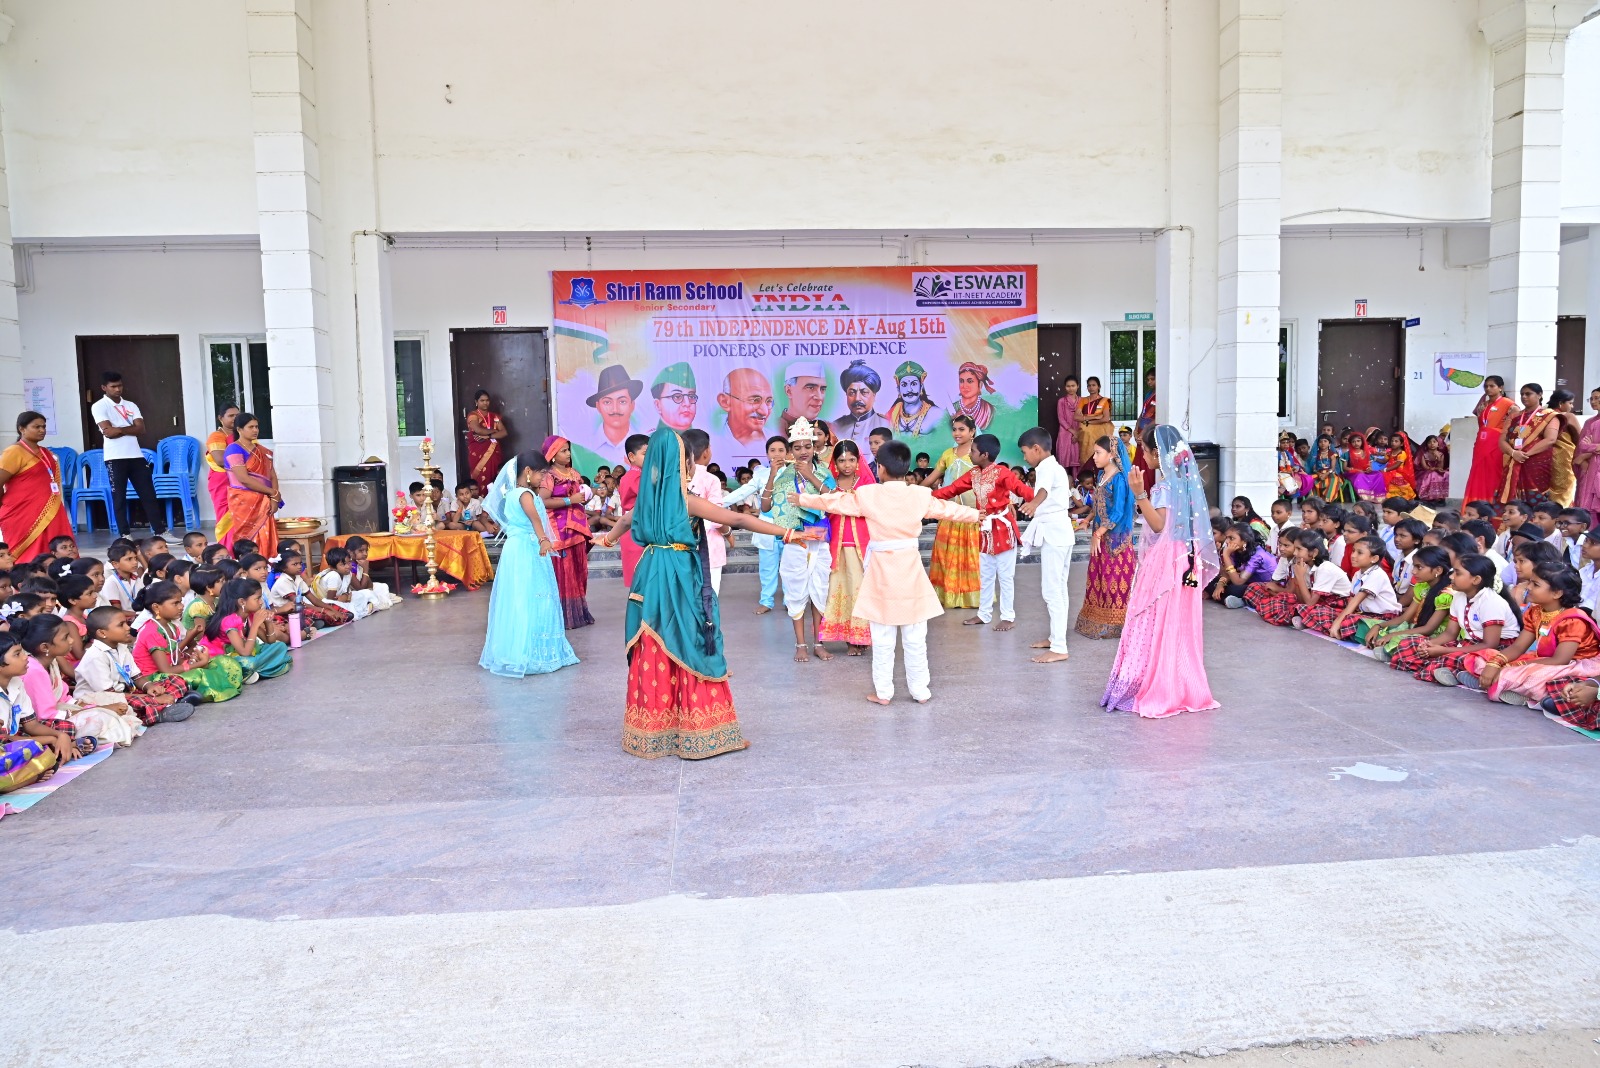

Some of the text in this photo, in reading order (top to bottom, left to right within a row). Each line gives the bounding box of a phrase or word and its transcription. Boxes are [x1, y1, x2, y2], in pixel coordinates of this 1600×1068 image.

[759, 283, 834, 293] Let's Celebrate
[954, 274, 1024, 290] ESWARI
[606, 281, 743, 302] Shri Ram School
[953, 291, 1023, 299] IIT-NEET ACADEMY
[634, 303, 716, 313] Senior Secondary
[752, 293, 850, 312] INDIA
[1356, 303, 1367, 316] 21
[494, 310, 506, 324] 20
[699, 317, 829, 338] INDEPENDENCE
[911, 316, 946, 335] 15th
[693, 341, 908, 359] PIONEERS OF INDEPENDENCE
[1413, 371, 1423, 380] 21
